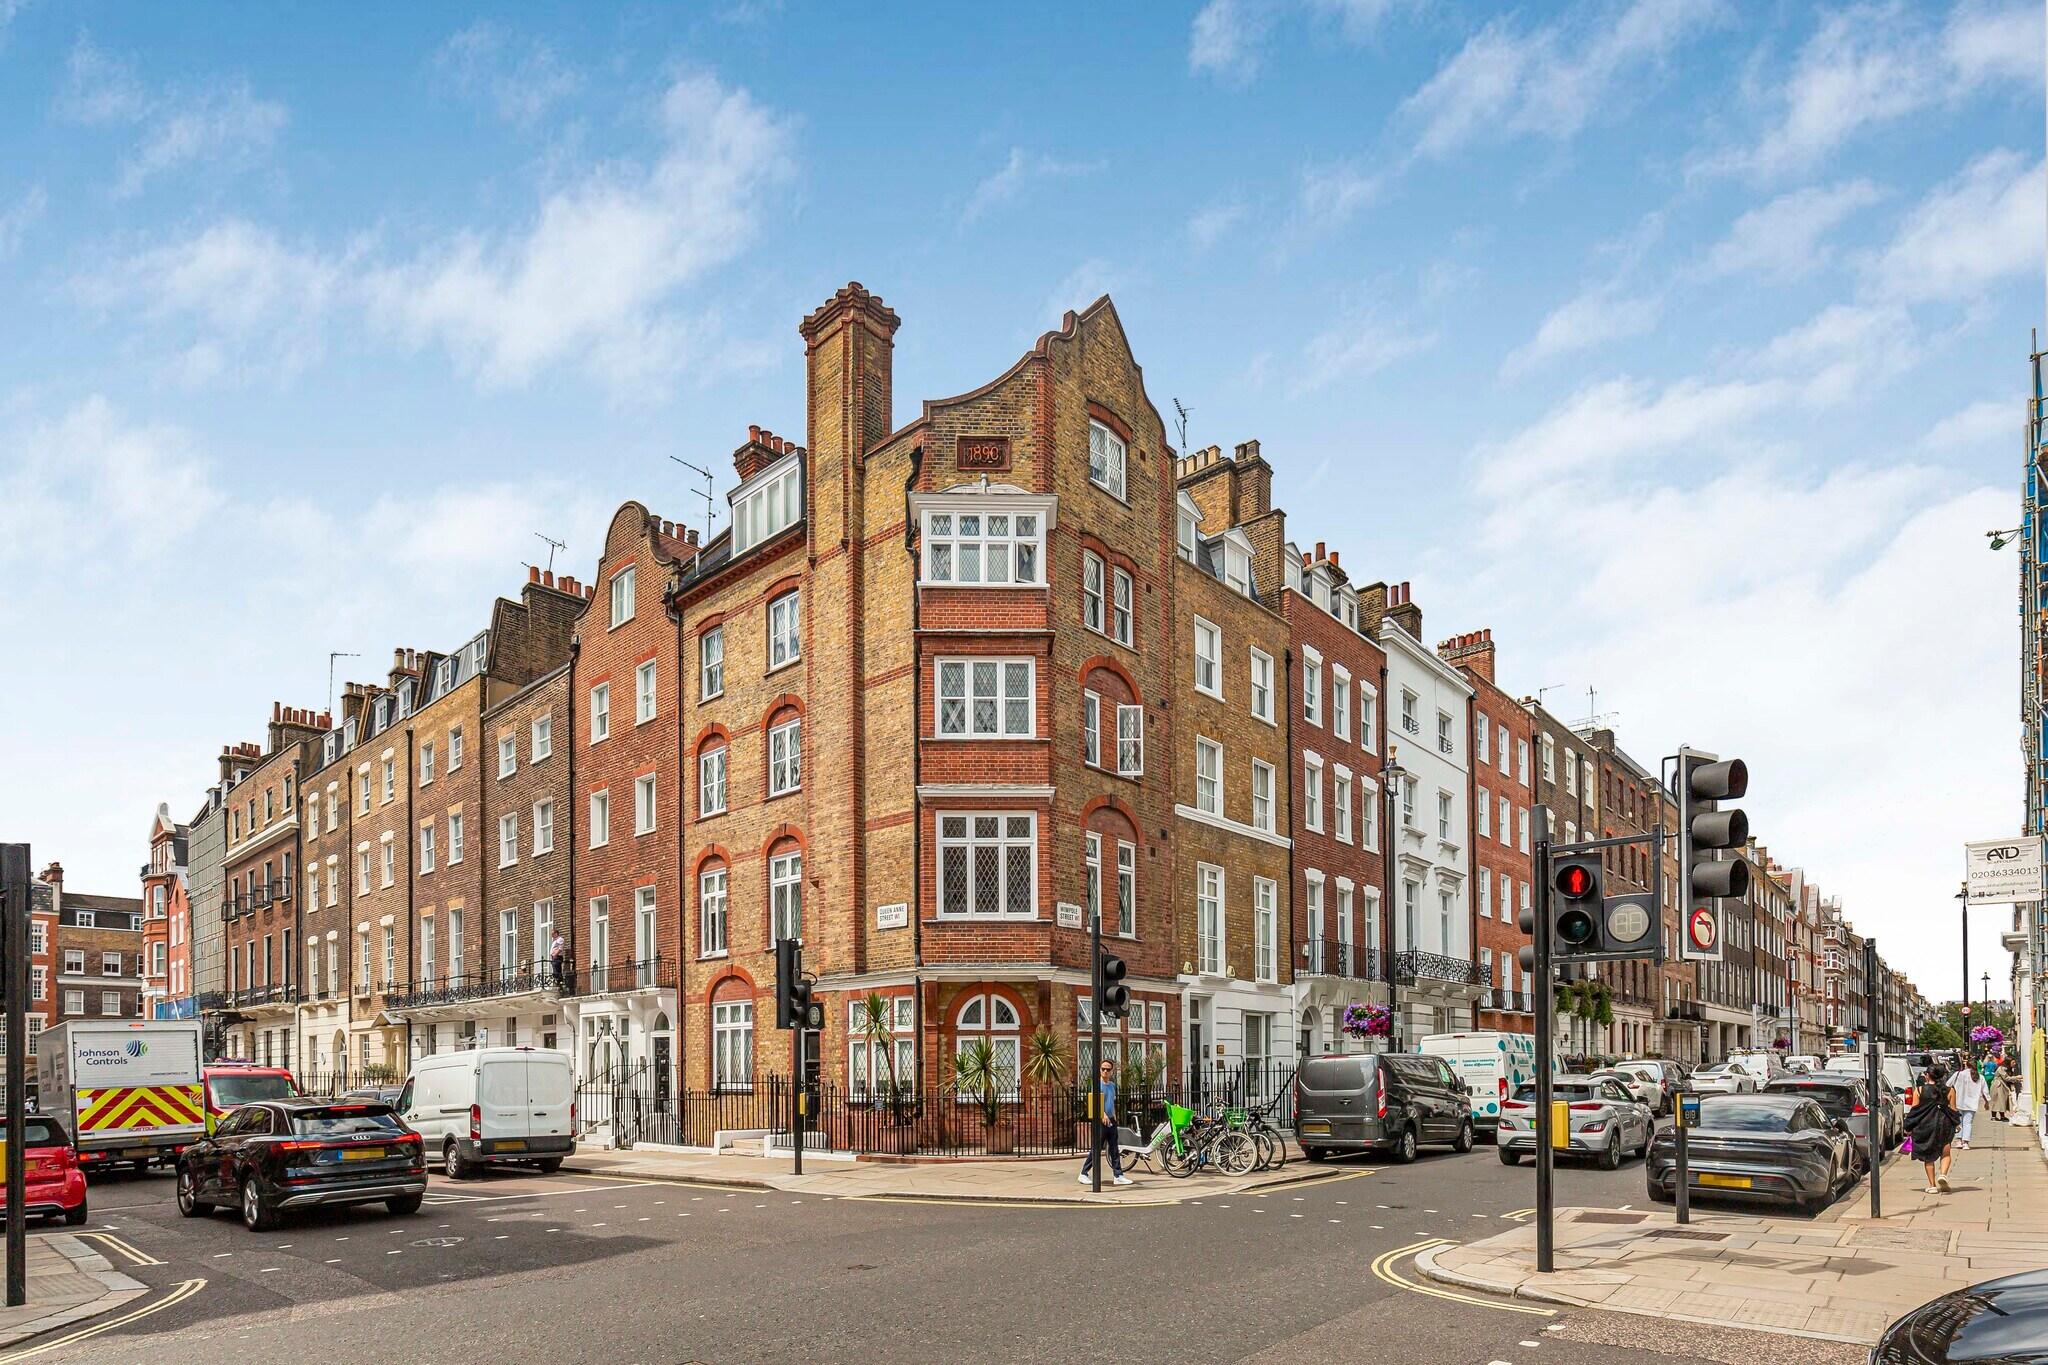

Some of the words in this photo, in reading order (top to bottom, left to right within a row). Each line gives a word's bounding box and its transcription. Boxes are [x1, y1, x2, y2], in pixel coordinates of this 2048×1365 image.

[969, 444, 998, 462] 1890
[1987, 846, 2020, 861] ATD
[1971, 867, 2039, 879] 02036334013
[78, 1049, 120, 1058] Johnson
[86, 1057, 128, 1066] Controls
